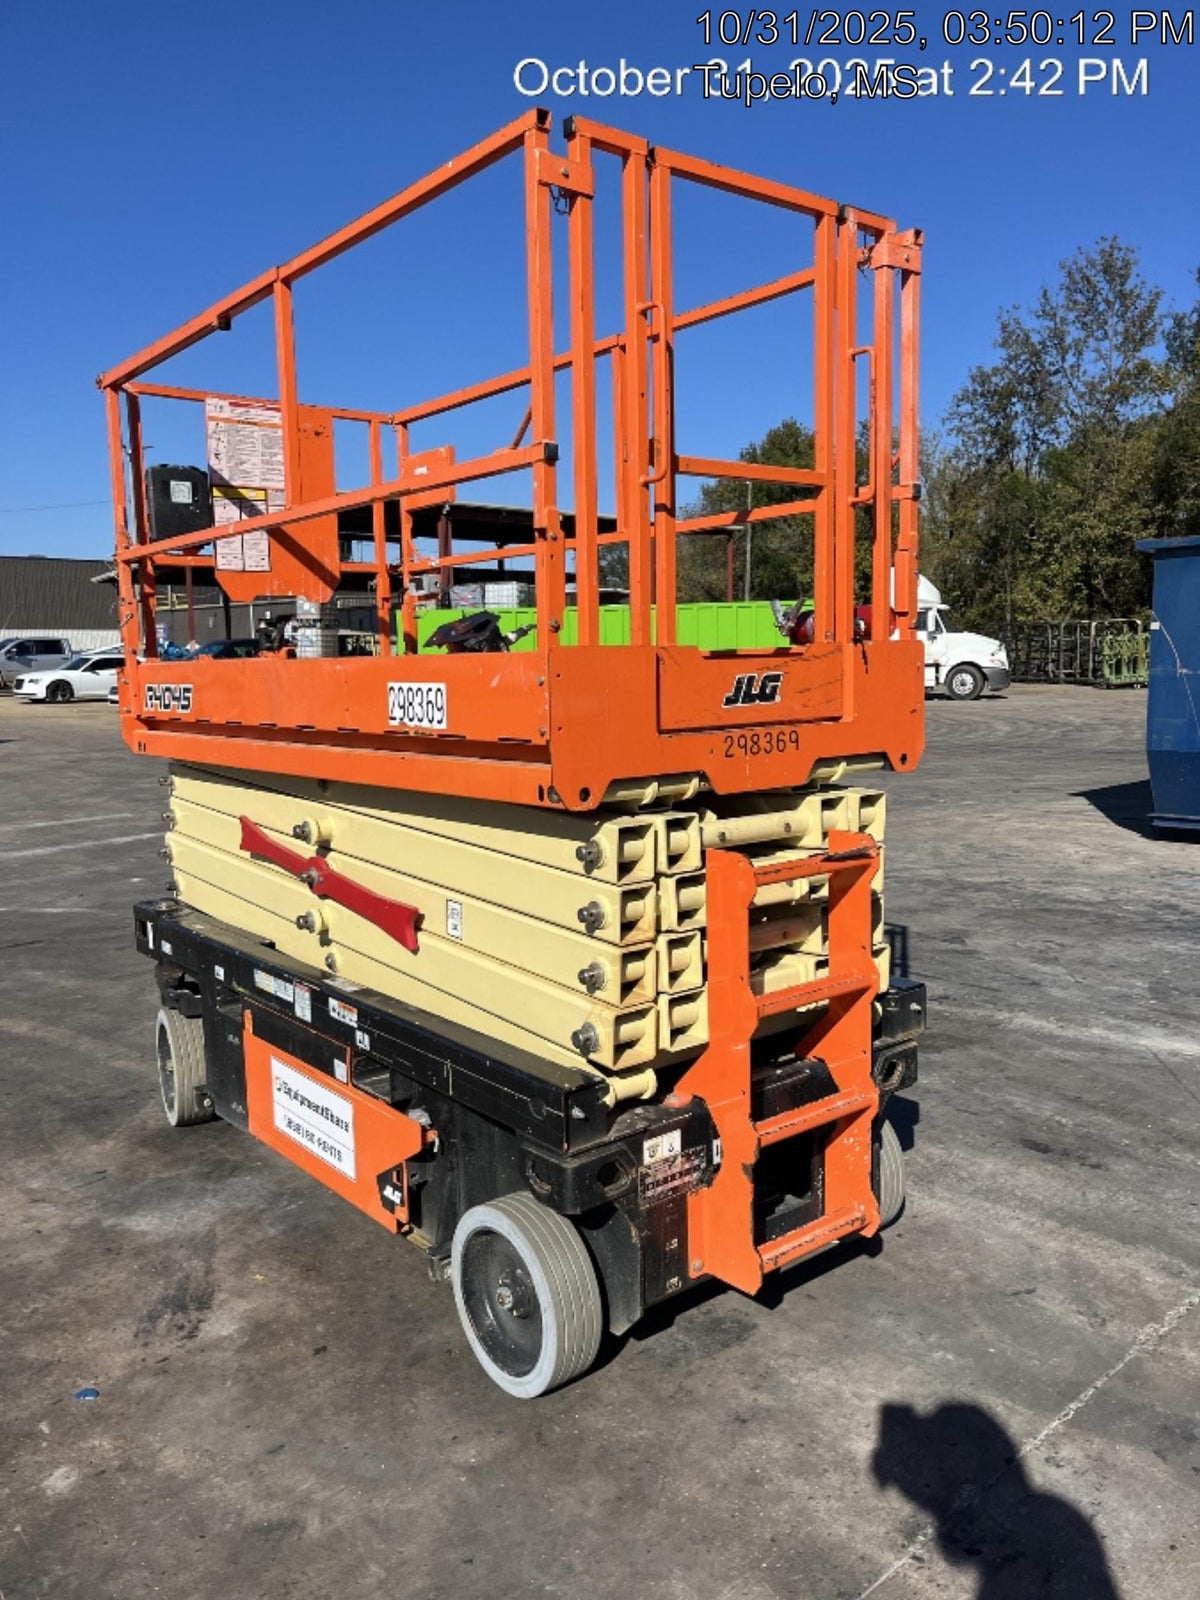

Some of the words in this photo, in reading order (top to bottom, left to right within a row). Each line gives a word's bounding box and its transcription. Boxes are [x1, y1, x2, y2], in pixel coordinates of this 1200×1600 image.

[388, 685, 445, 725] 298369
[721, 671, 784, 708] JLG
[723, 729, 800, 759] 298369
